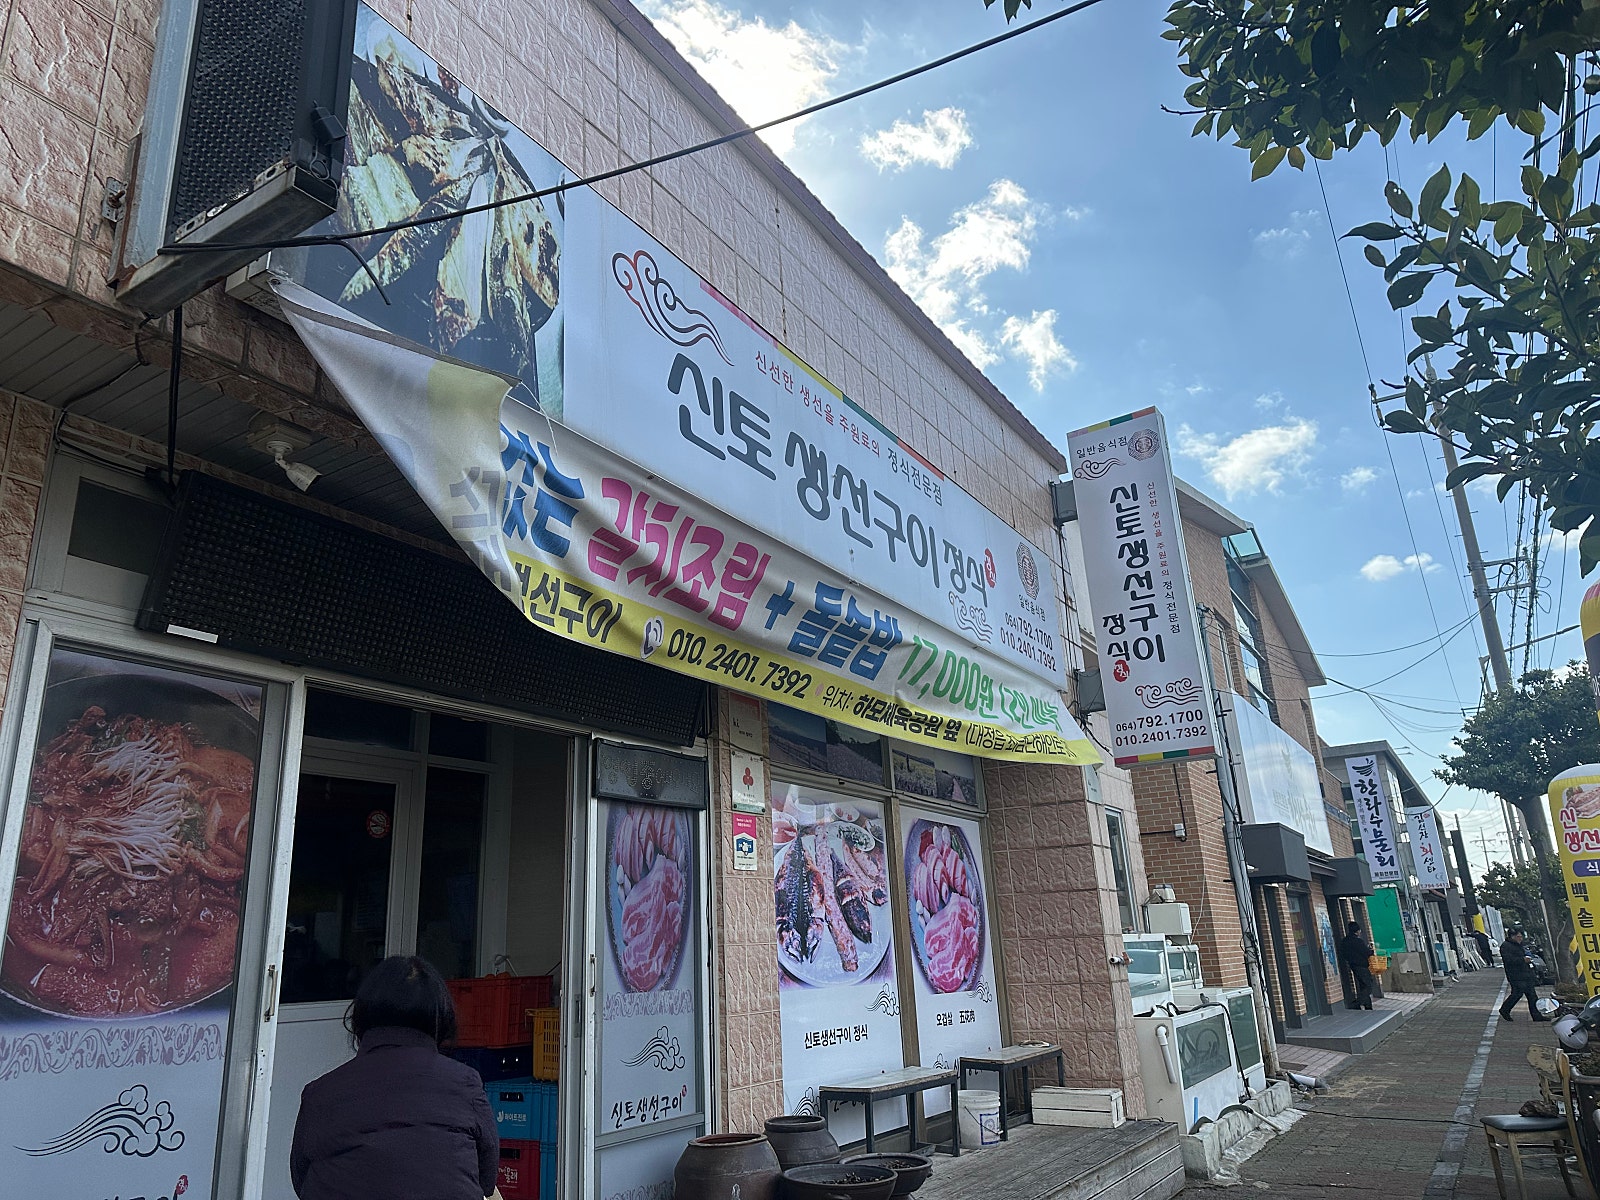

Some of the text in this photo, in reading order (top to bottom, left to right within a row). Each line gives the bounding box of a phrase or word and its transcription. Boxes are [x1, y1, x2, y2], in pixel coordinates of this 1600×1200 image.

[755, 350, 942, 506] 신선한 생선을 주원료의 정식전문점
[1076, 435, 1128, 459] 일반음식점
[667, 353, 988, 608] 신토 생선구이 정식
[1147, 481, 1158, 507] 신선한
[1162, 581, 1180, 633] 정식전문점
[587, 477, 772, 631] 갈치조림
[786, 580, 904, 682] 돌솥밥
[898, 634, 999, 719] 17,000원
[1000, 627, 1057, 672] 010.2401.7392
[1004, 612, 1053, 651] 064)792.1700
[1102, 613, 1131, 661] 정식
[822, 685, 853, 711] 위치:
[852, 694, 943, 739] 하모체육공원
[942, 719, 962, 743] 옆
[1115, 725, 1207, 747] 010.2401.7392
[1116, 709, 1204, 732] 064)792.1700
[1354, 778, 1395, 867] 한라수물회
[804, 1023, 869, 1049] 신토생선구이 정식
[936, 1012, 953, 1026] 오겹살
[611, 1093, 682, 1128] 신토생선구이
